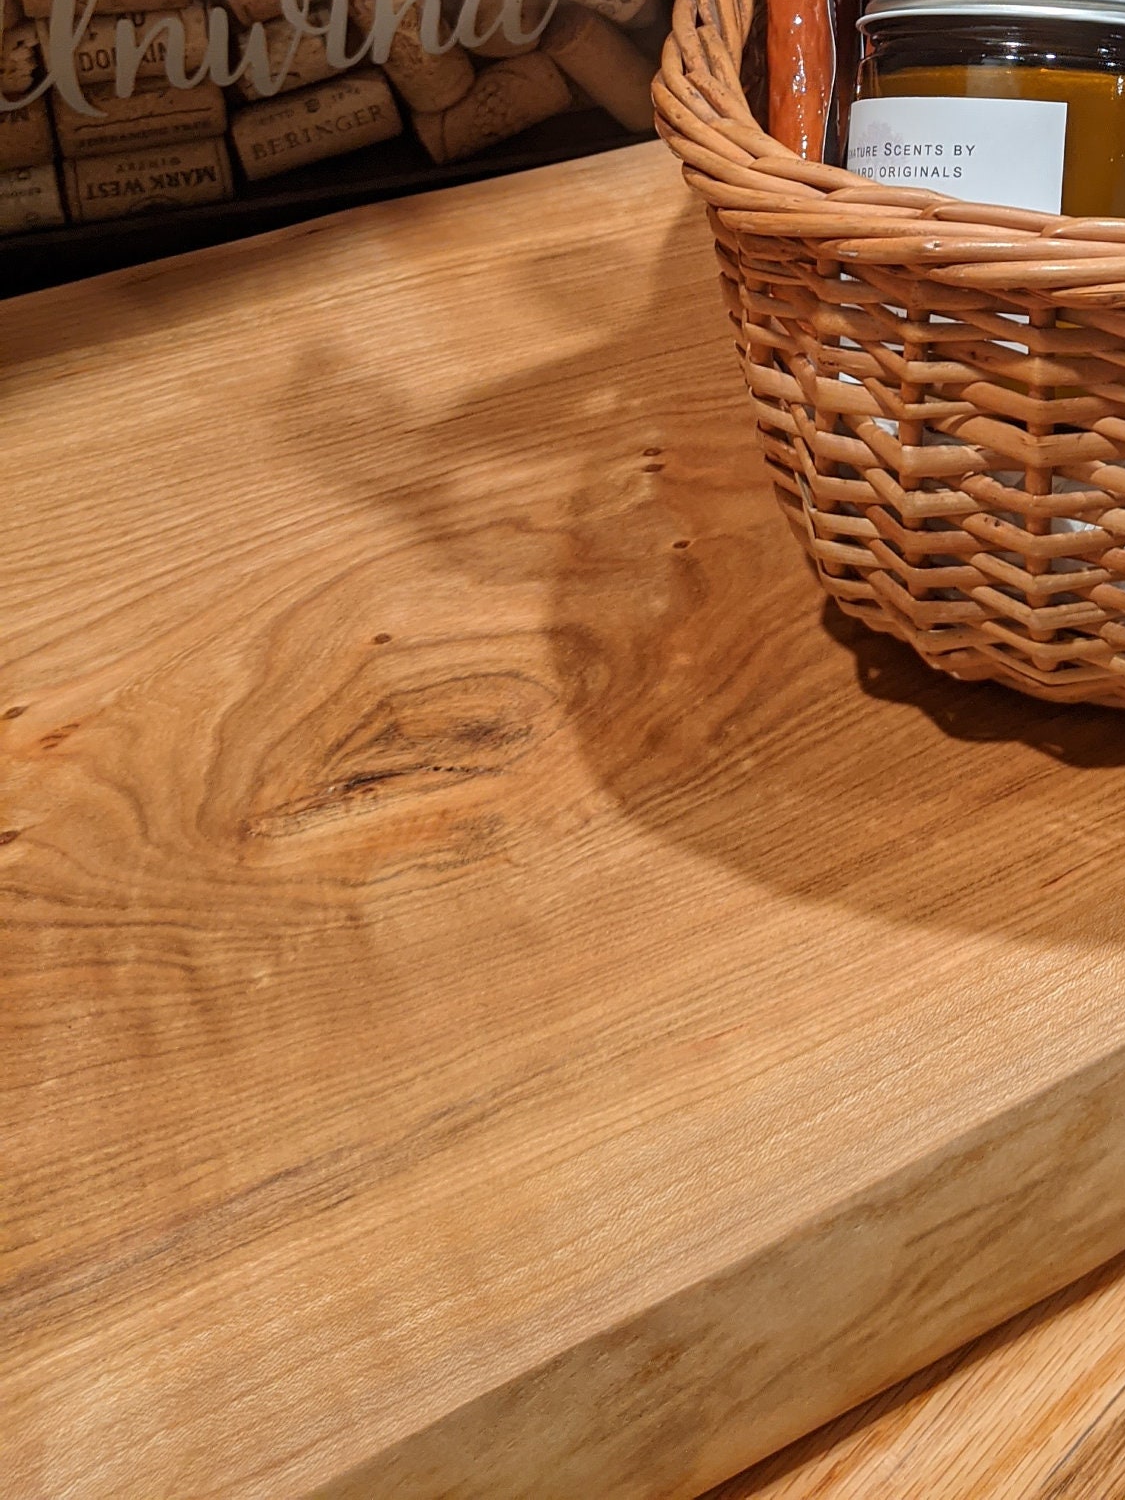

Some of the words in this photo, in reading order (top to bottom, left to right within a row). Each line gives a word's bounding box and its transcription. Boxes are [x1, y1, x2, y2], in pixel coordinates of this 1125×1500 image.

[252, 102, 387, 161] BERINGER
[954, 144, 976, 157] BY
[152, 165, 217, 190] MARK
[879, 165, 963, 179] ORIGINALS
[86, 177, 146, 201] WEST
